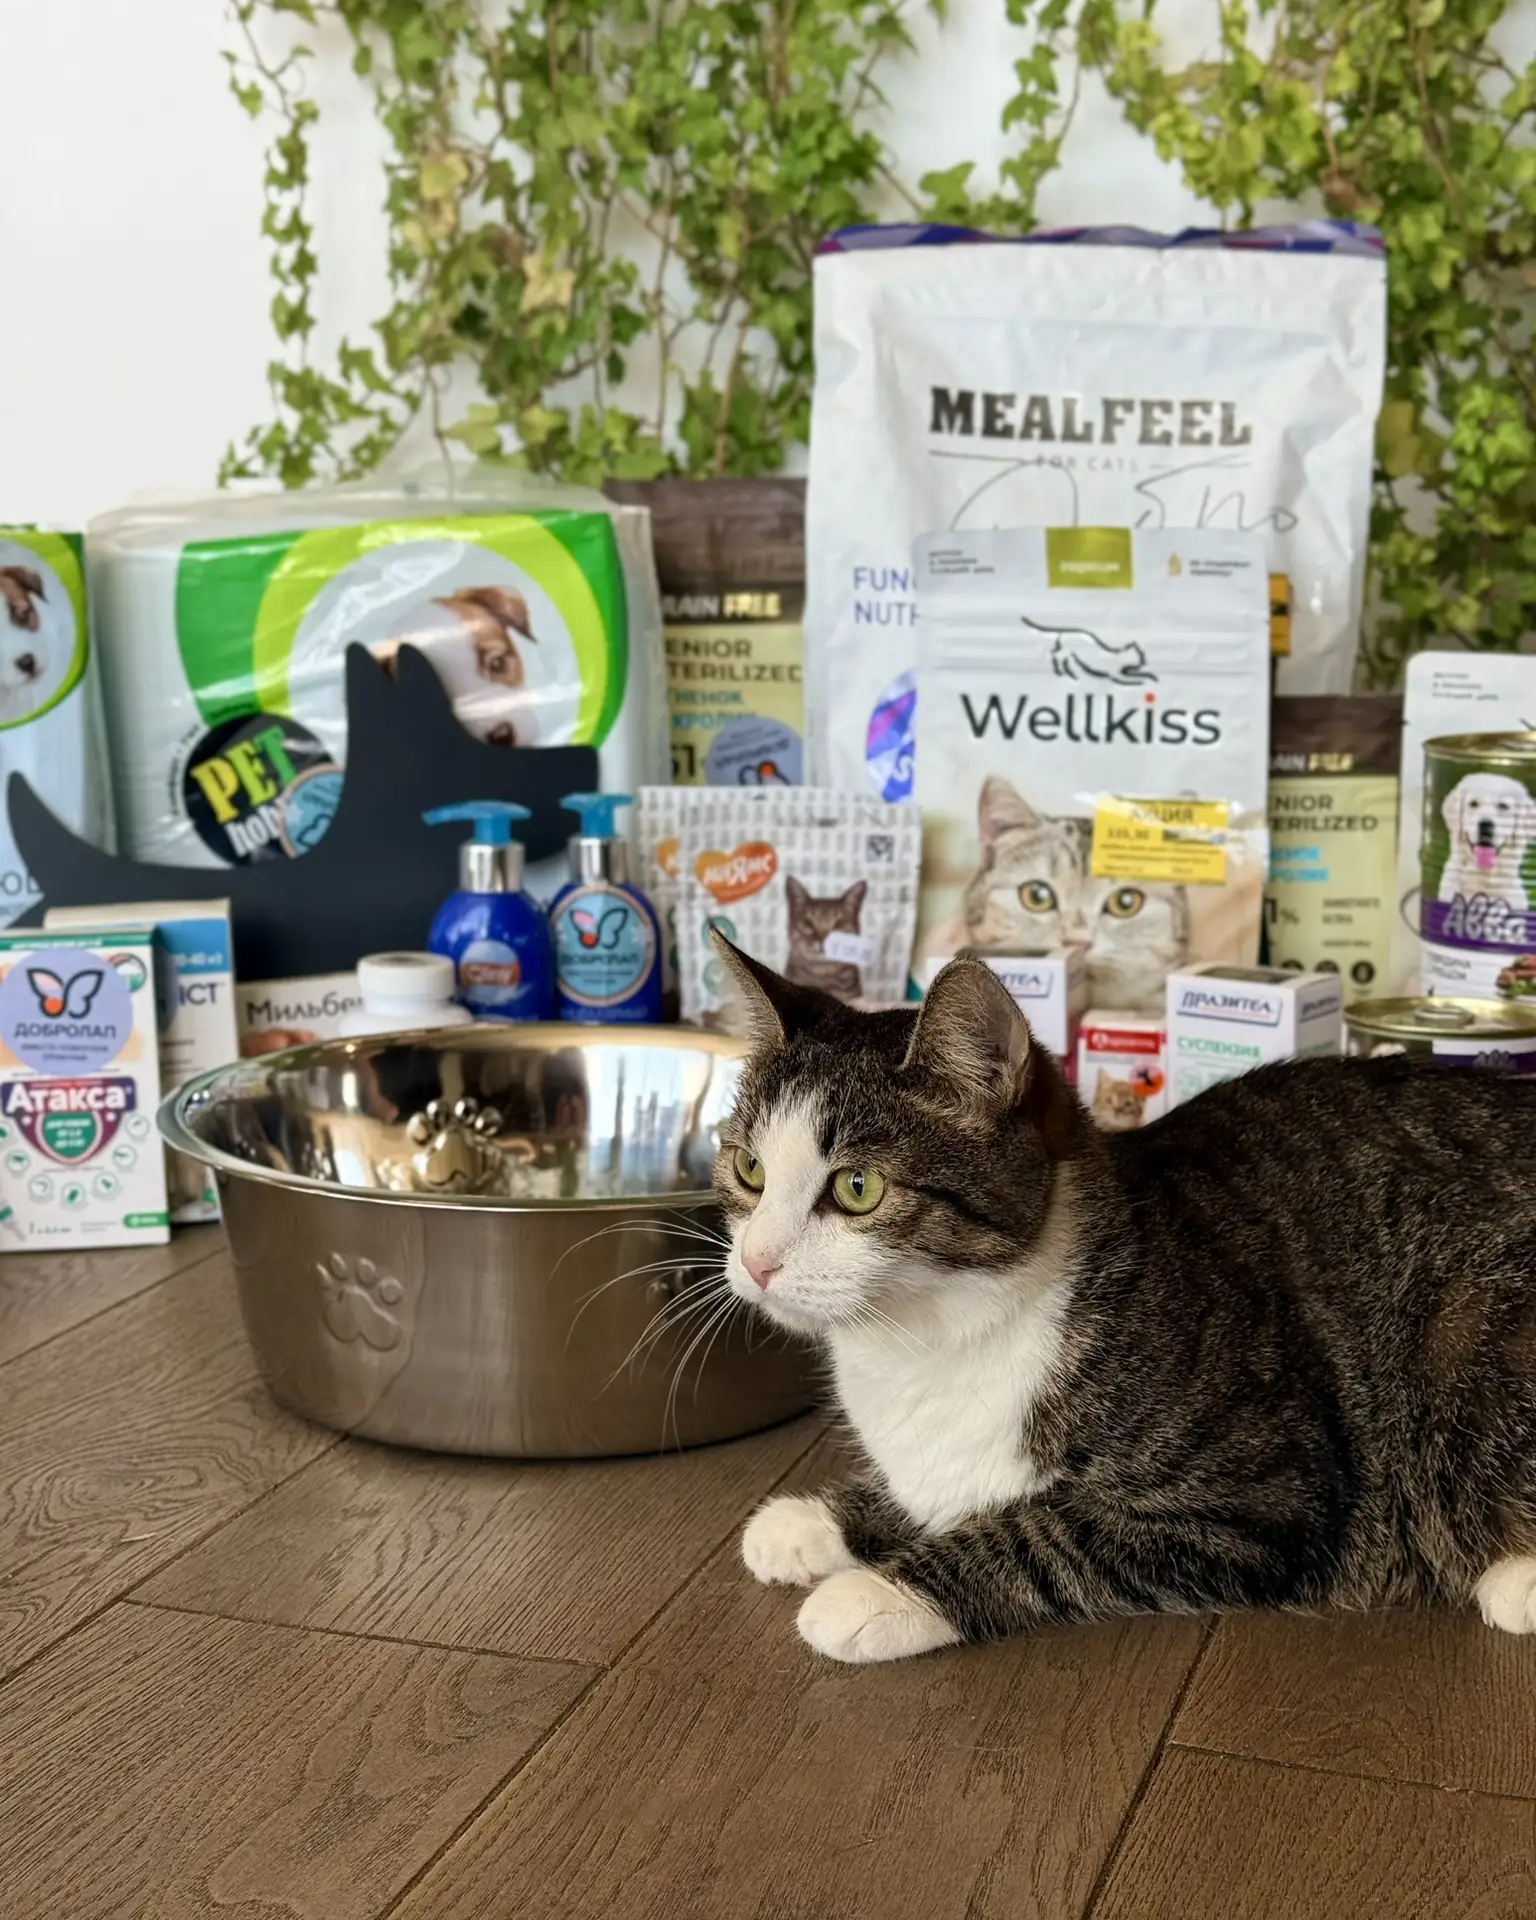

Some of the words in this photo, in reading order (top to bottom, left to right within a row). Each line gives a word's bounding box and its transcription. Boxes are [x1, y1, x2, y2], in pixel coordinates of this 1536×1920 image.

[929, 386, 1252, 447] MEALFEEL
[1035, 453, 1079, 470] FOR
[1086, 456, 1139, 474] CATS
[853, 567, 917, 592] FUN
[723, 592, 782, 618] FREE
[960, 691, 1222, 746] Wellkiss
[189, 725, 298, 826] PET
[1182, 991, 1274, 1014] ПРАЗИТЕЛ
[15, 1022, 117, 1039] ДОБРОЛАП
[4, 1080, 127, 1115] Атакса
